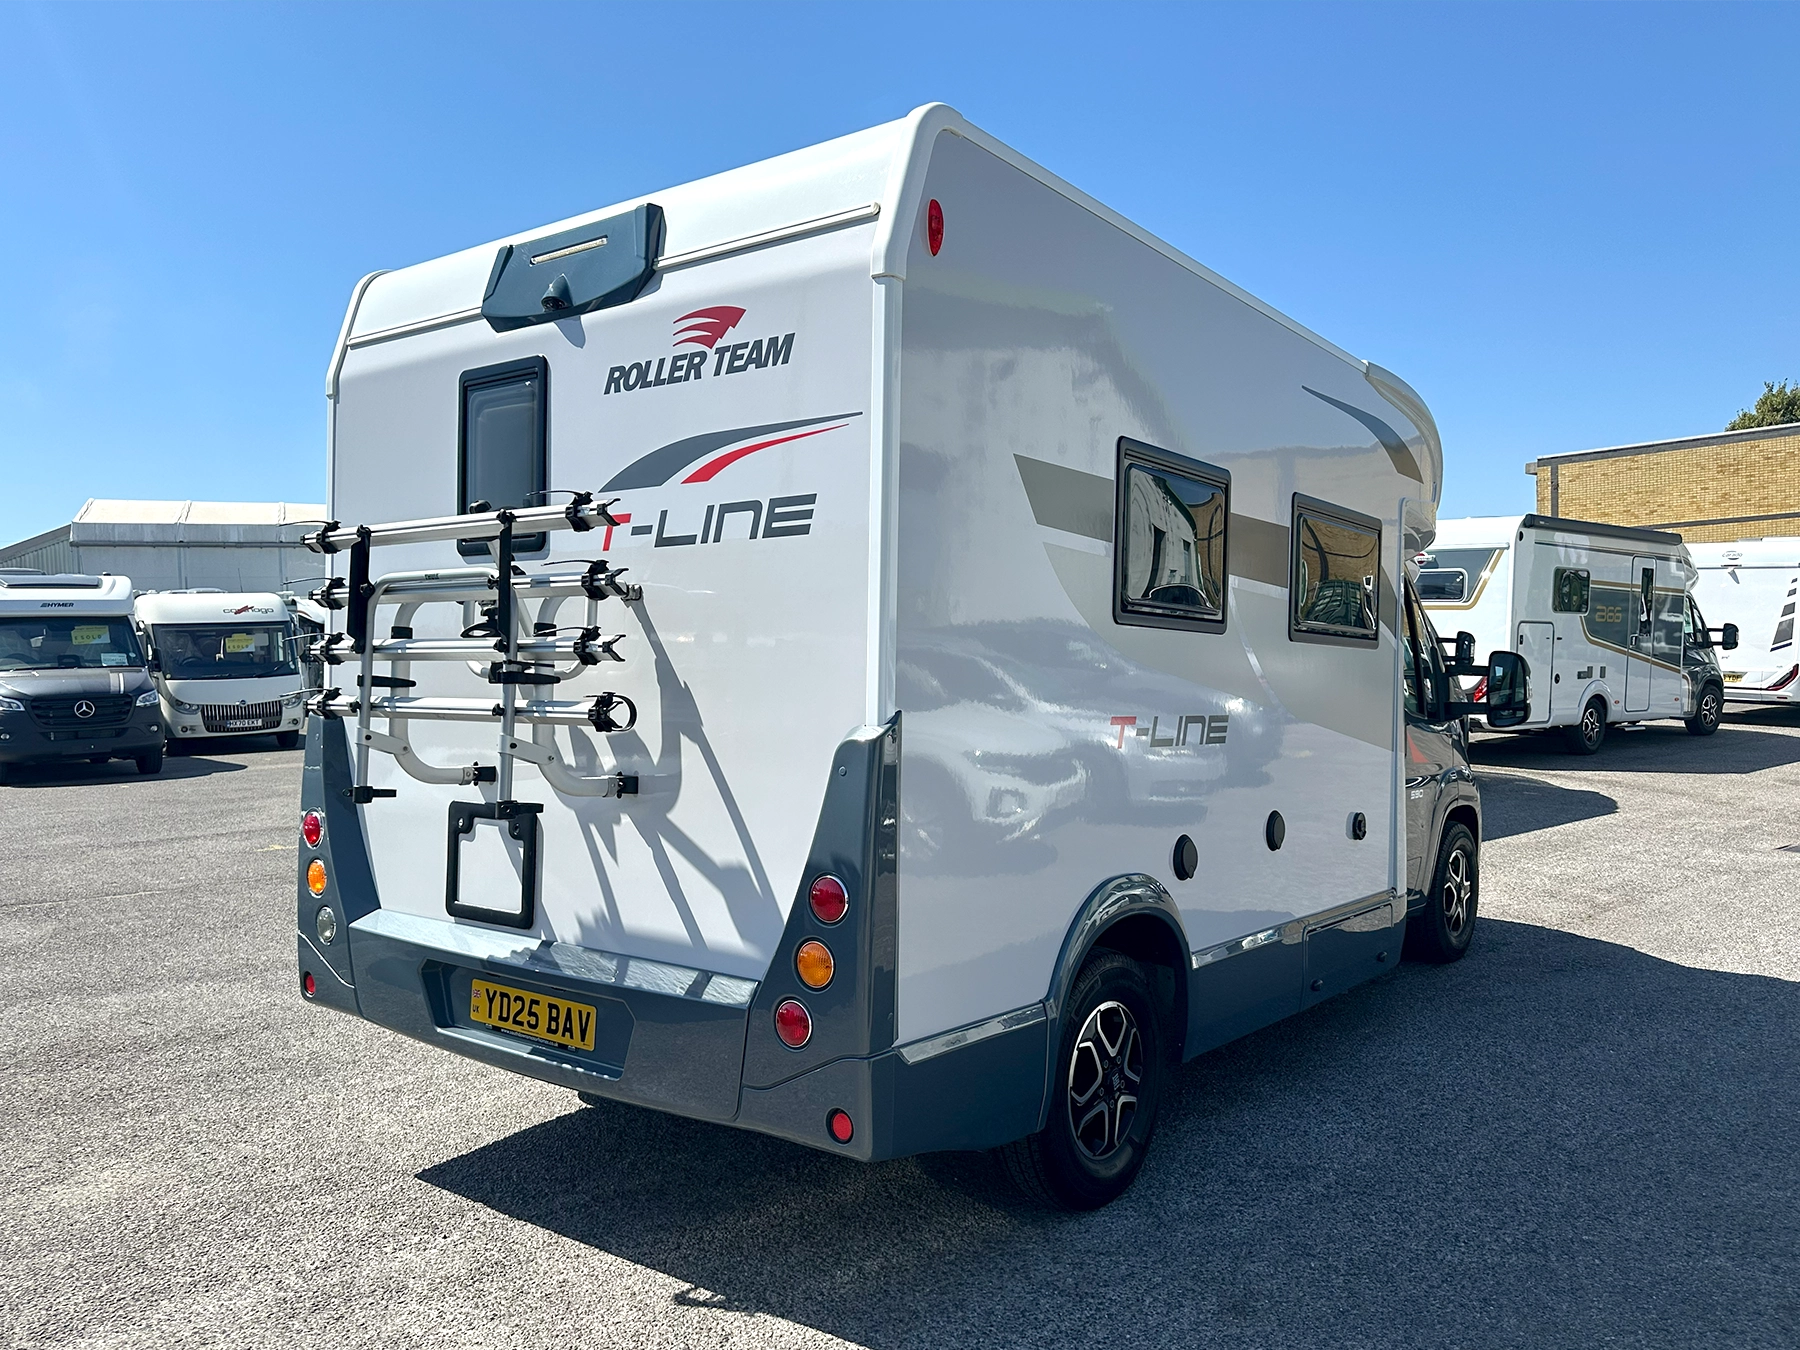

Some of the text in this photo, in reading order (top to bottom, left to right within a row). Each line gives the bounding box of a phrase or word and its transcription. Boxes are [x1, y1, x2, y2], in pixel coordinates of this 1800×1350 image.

[603, 332, 796, 396] ROLLER TEAM
[602, 493, 818, 552] T-LINE
[223, 605, 274, 615] caago
[1110, 714, 1230, 750] T-LINE
[485, 987, 592, 1043] YD25 BAV
